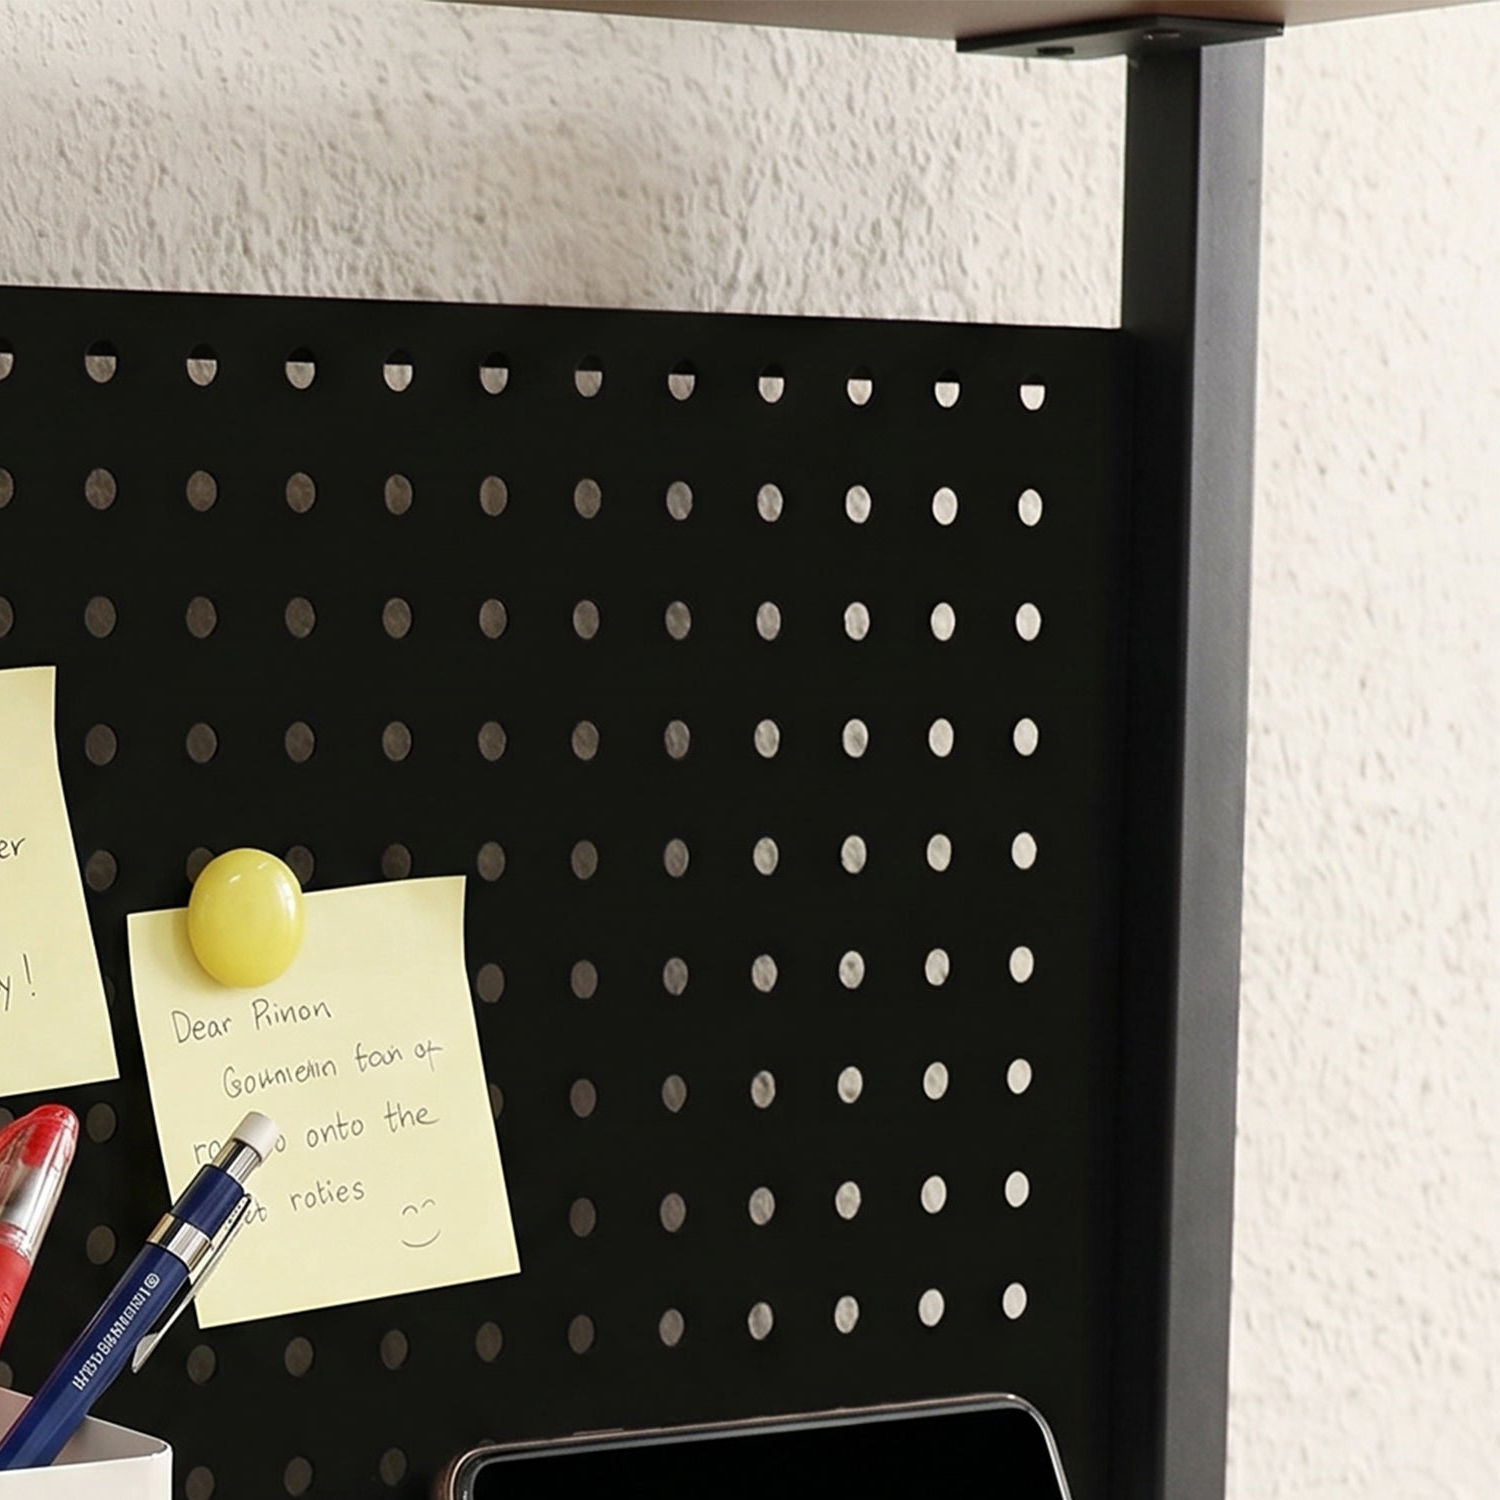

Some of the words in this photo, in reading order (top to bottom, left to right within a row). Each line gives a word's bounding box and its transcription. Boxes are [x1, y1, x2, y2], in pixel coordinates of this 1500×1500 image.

[170, 1009, 233, 1045] Dear
[305, 1110, 365, 1149] onto
[382, 1099, 441, 1134] the
